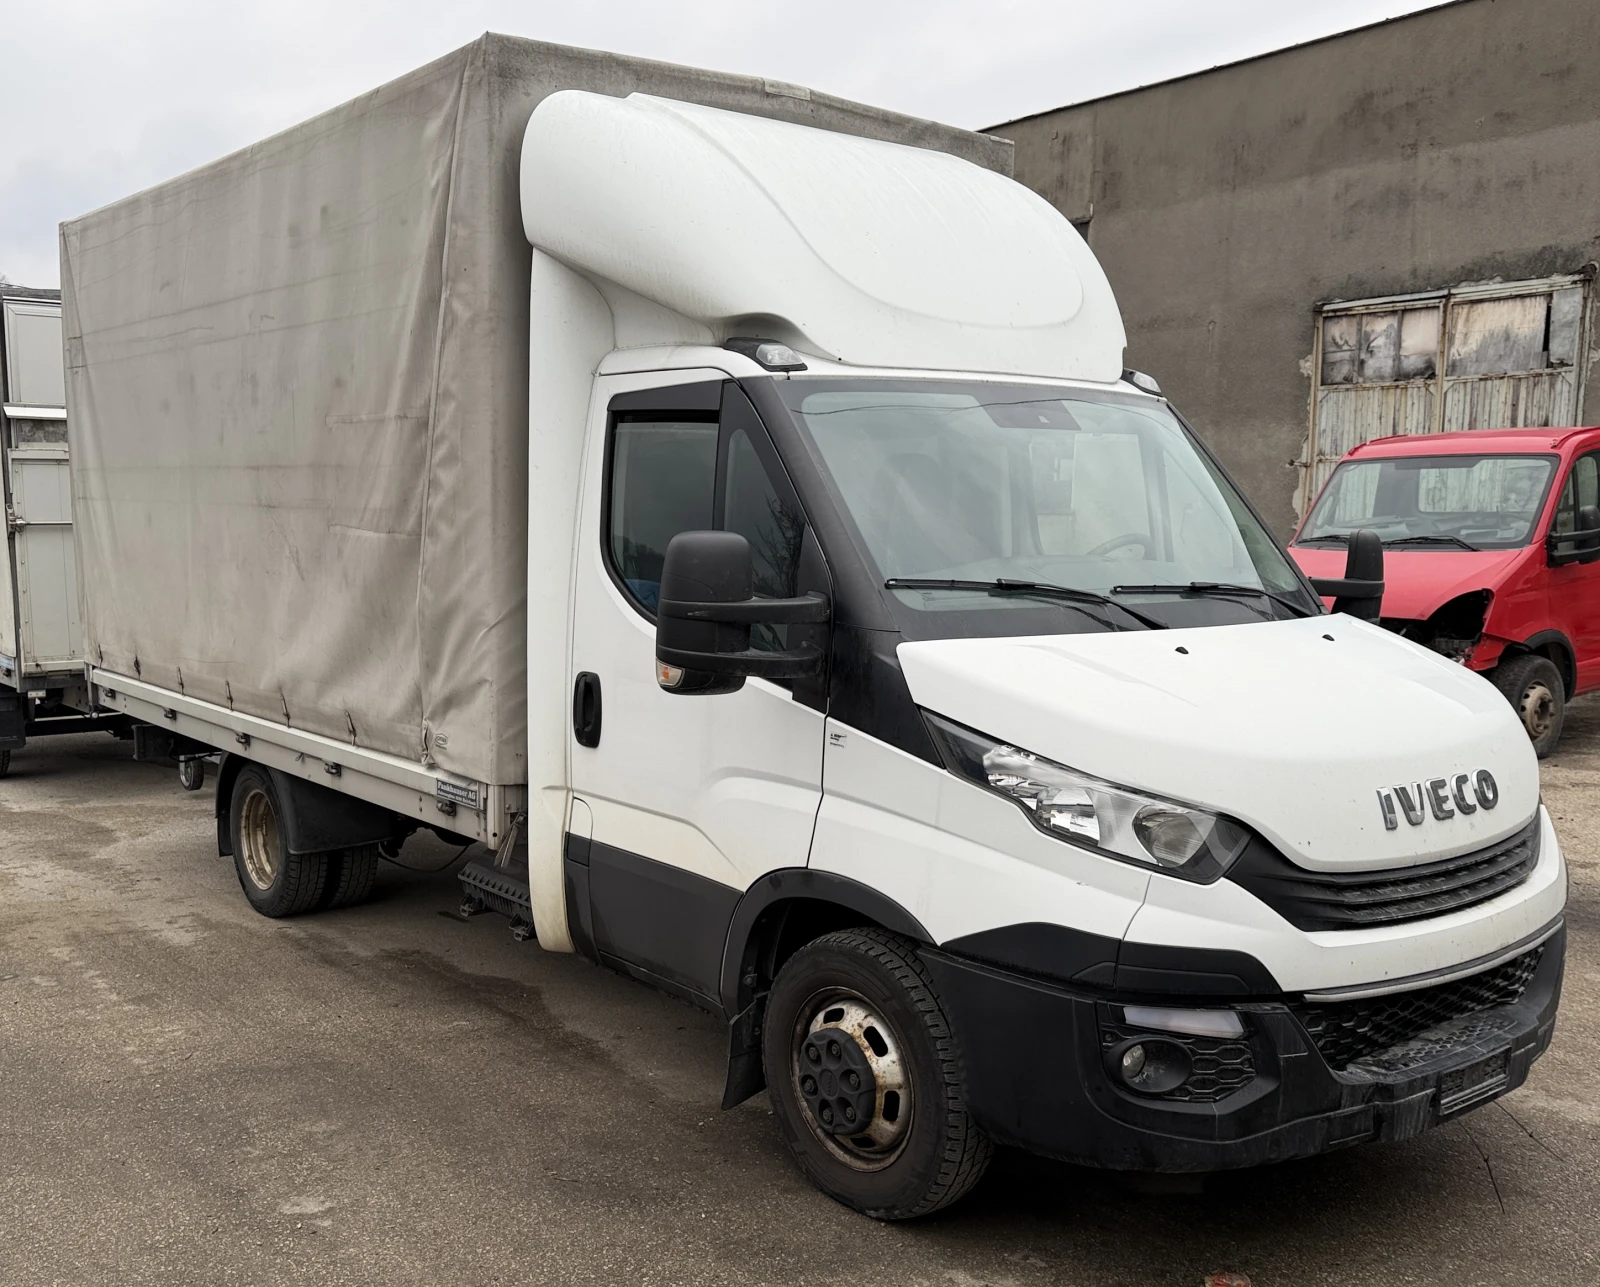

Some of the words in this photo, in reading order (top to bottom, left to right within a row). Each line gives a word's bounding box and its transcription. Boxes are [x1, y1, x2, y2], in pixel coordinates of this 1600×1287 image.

[437, 781, 468, 797] Fankhauser
[467, 792, 476, 800] AG
[1376, 768, 1499, 831] IVECO
